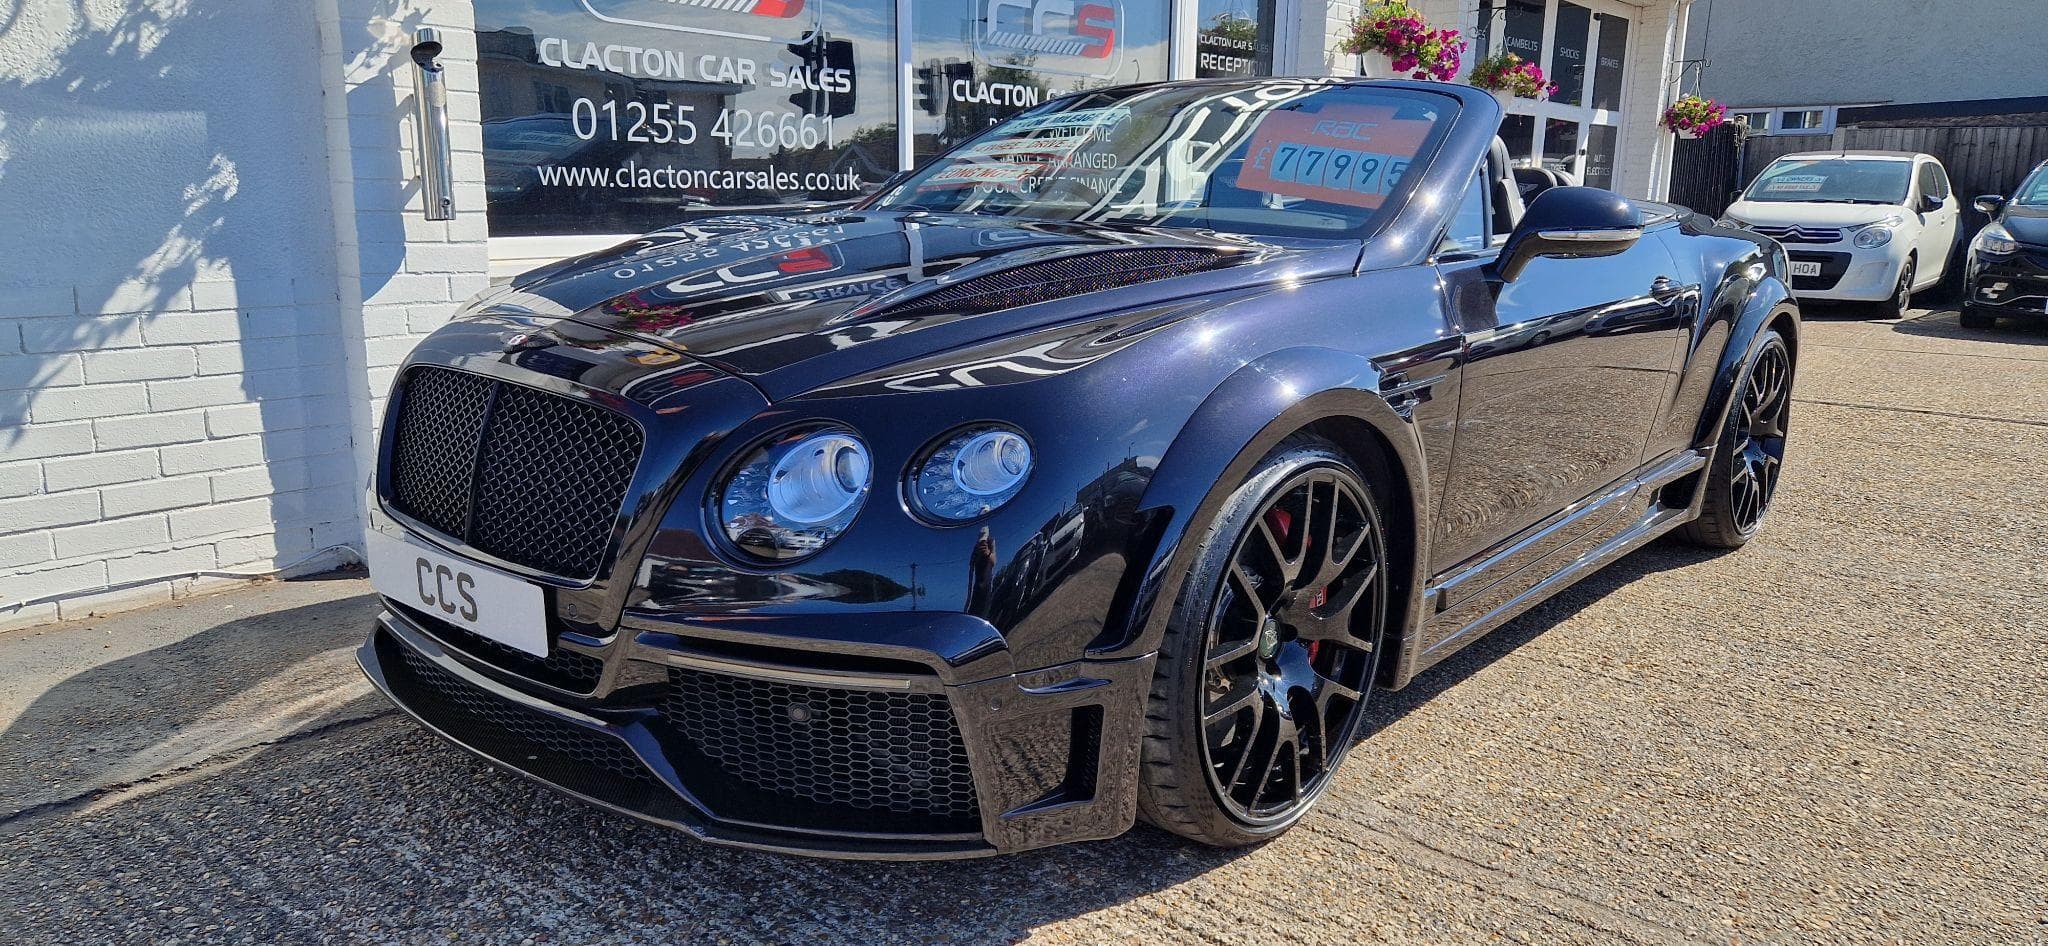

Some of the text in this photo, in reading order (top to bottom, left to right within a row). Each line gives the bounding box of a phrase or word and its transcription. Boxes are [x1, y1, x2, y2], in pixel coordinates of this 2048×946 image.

[1200, 34, 1232, 48] CLACTON
[1233, 40, 1247, 50] CAR
[1506, 36, 1539, 51] CAMBELTS
[1560, 46, 1580, 59] SHOCKS
[539, 37, 852, 93] CLACTON CAR SALES
[1200, 53, 1267, 77] RECEPTION
[1600, 56, 1619, 68] BRAKES
[952, 79, 1038, 107] CLACTON
[572, 97, 836, 151] 01255 426661
[536, 160, 861, 192] www.clactoncarsales.co.uk
[1793, 263, 1817, 275] HOA
[416, 557, 478, 623] CCS
